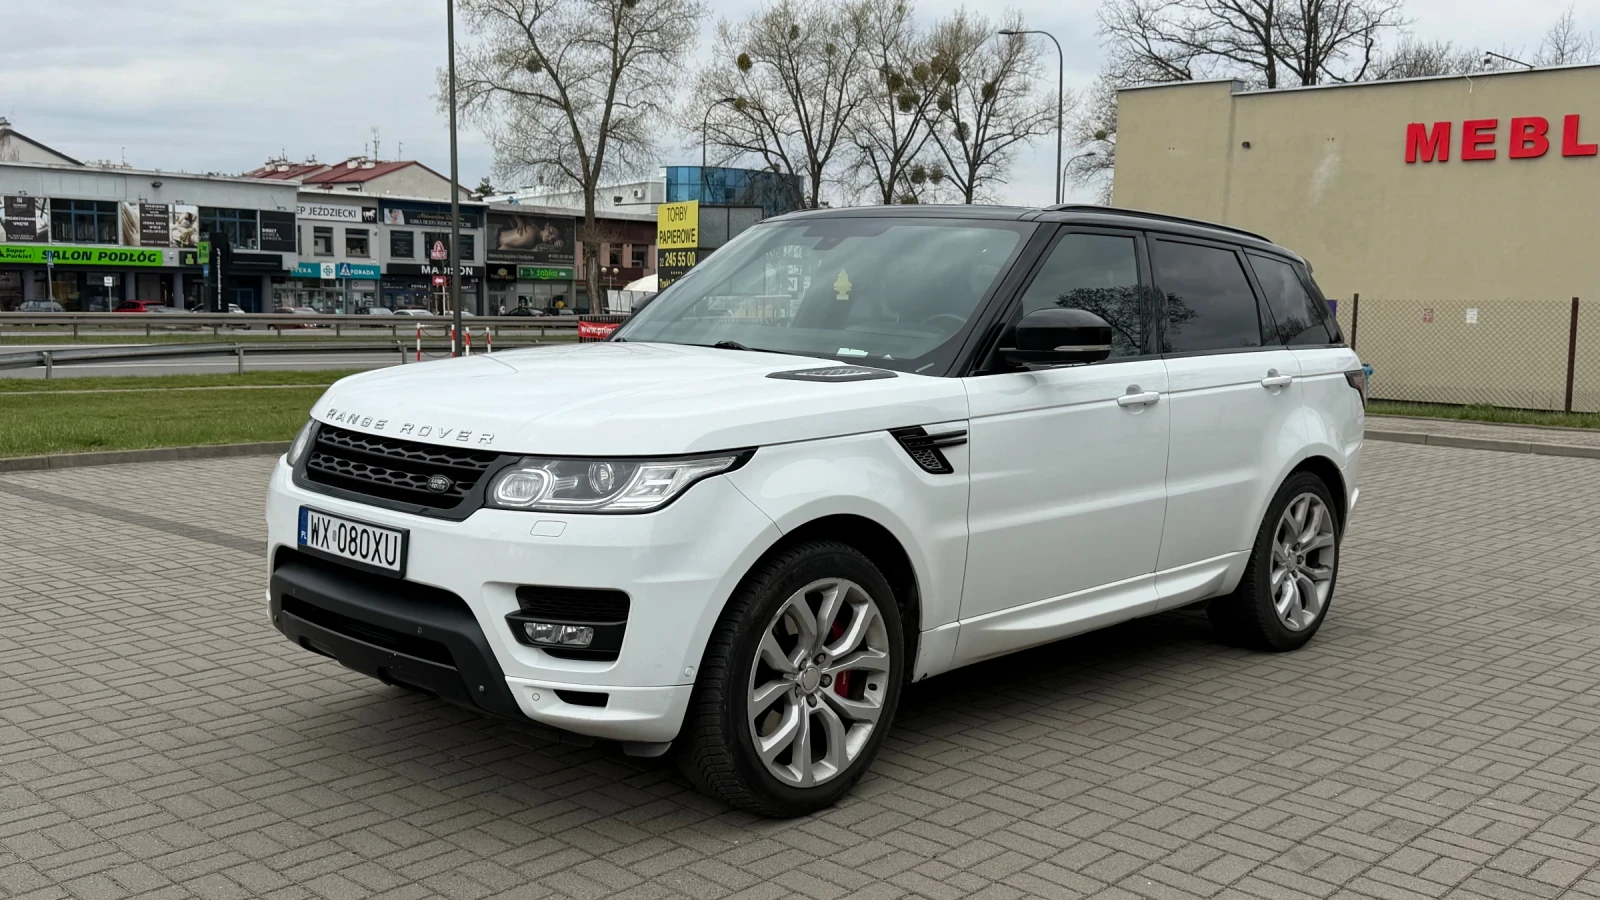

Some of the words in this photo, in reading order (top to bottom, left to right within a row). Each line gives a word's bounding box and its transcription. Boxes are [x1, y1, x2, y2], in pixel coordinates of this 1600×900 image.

[1405, 114, 1598, 163] MEBL
[308, 206, 356, 218] JEŹDZIECKI
[666, 206, 688, 222] TORBY
[660, 228, 696, 244] PAPIEROWE
[41, 250, 92, 260] SALON
[98, 250, 156, 262] PODŁÓG
[660, 258, 664, 266] 22
[665, 252, 676, 266] 245
[678, 252, 686, 266] 55
[686, 251, 696, 266] 00
[422, 265, 473, 275] MAION
[326, 408, 388, 430] RANGE
[400, 422, 495, 444] ROVER
[310, 514, 331, 550] WX
[338, 522, 398, 566] 080XU
